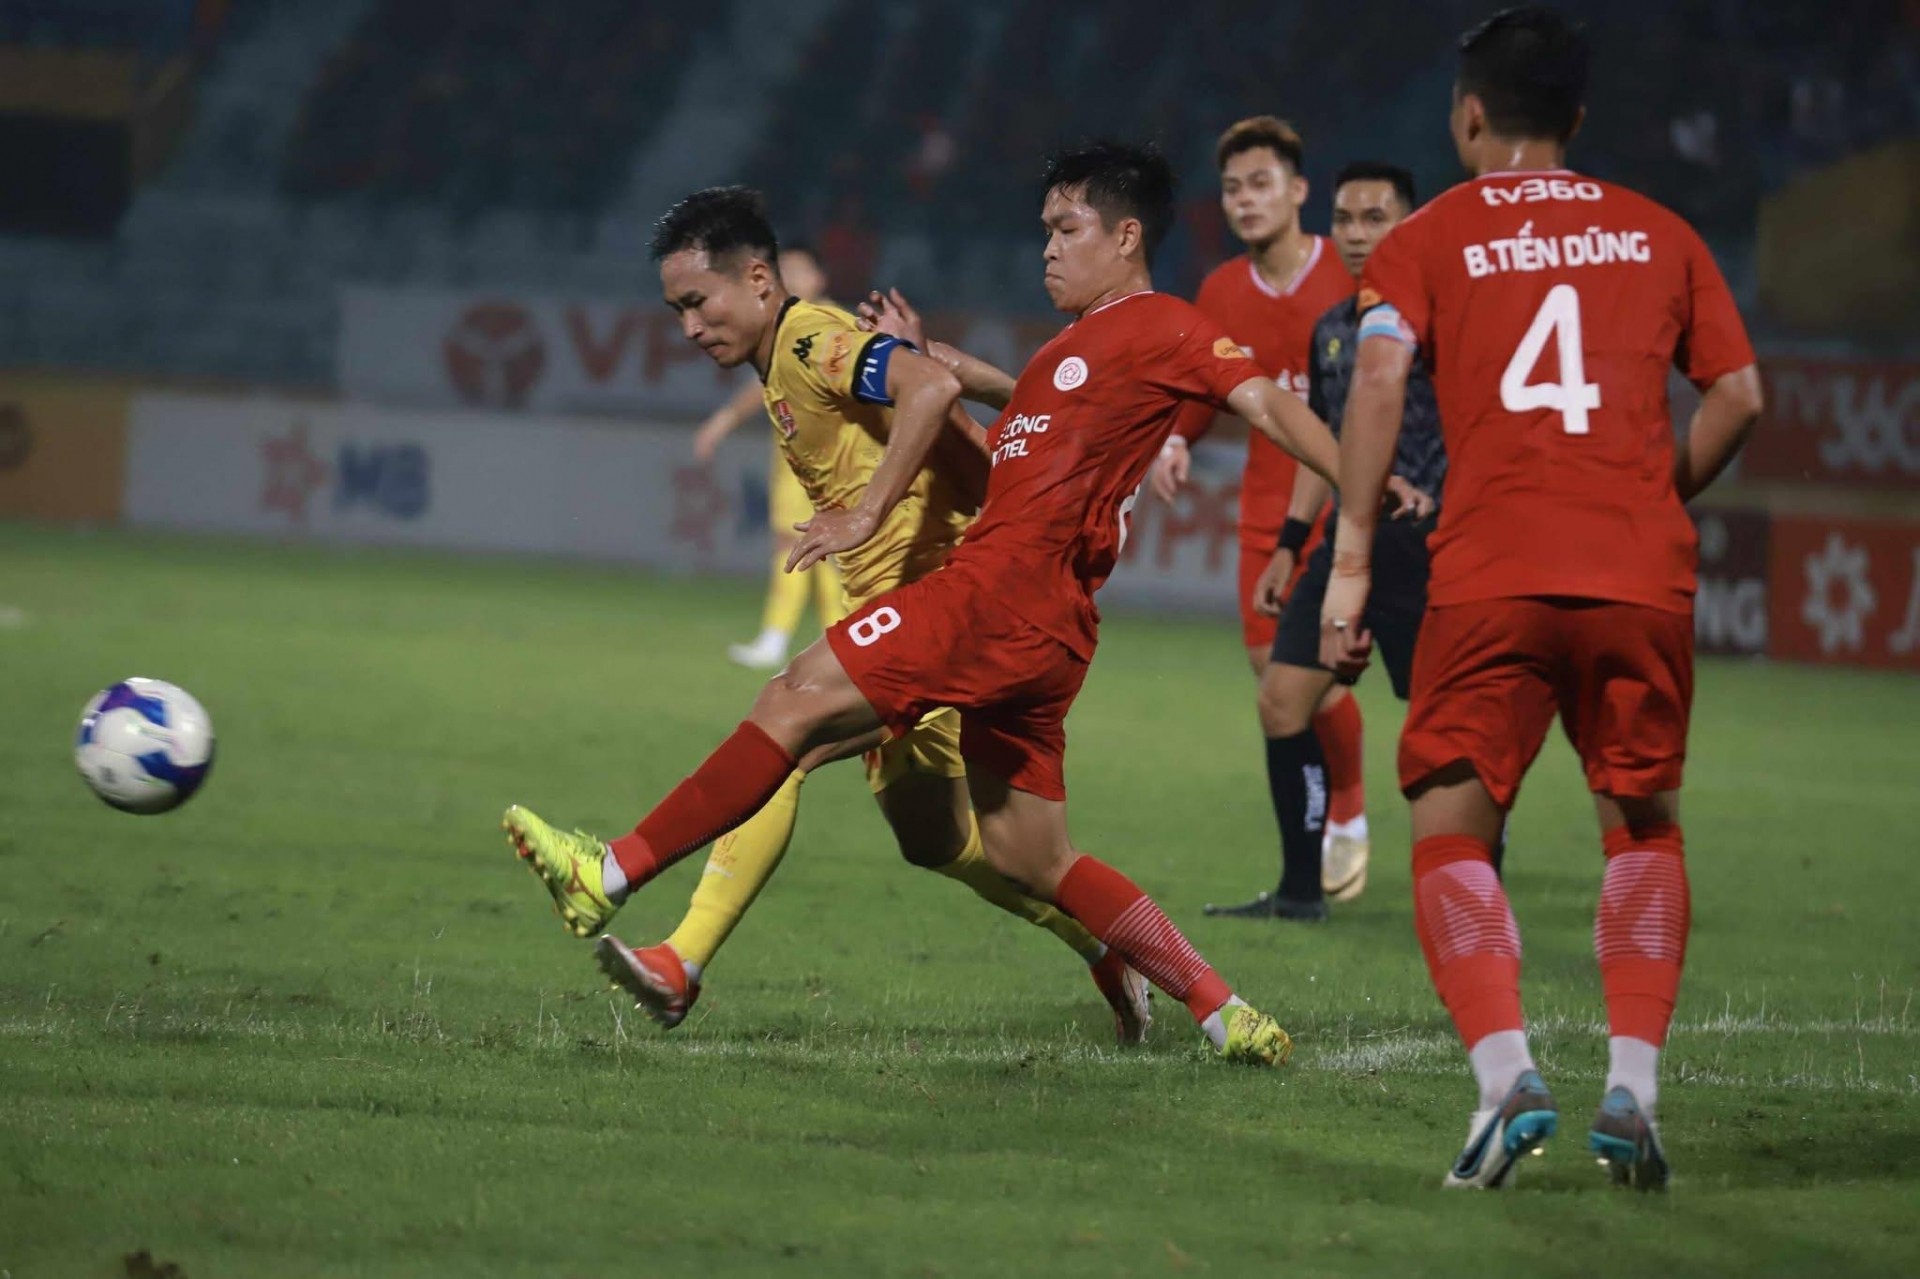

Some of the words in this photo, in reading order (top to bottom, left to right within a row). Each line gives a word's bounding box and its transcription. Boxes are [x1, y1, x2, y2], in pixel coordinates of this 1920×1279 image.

[1480, 179, 1603, 206] tv360
[1463, 220, 1560, 277] B.TIẾN
[1562, 226, 1651, 267] DŨNG
[1500, 284, 1601, 434] 4
[848, 606, 901, 646] 8
